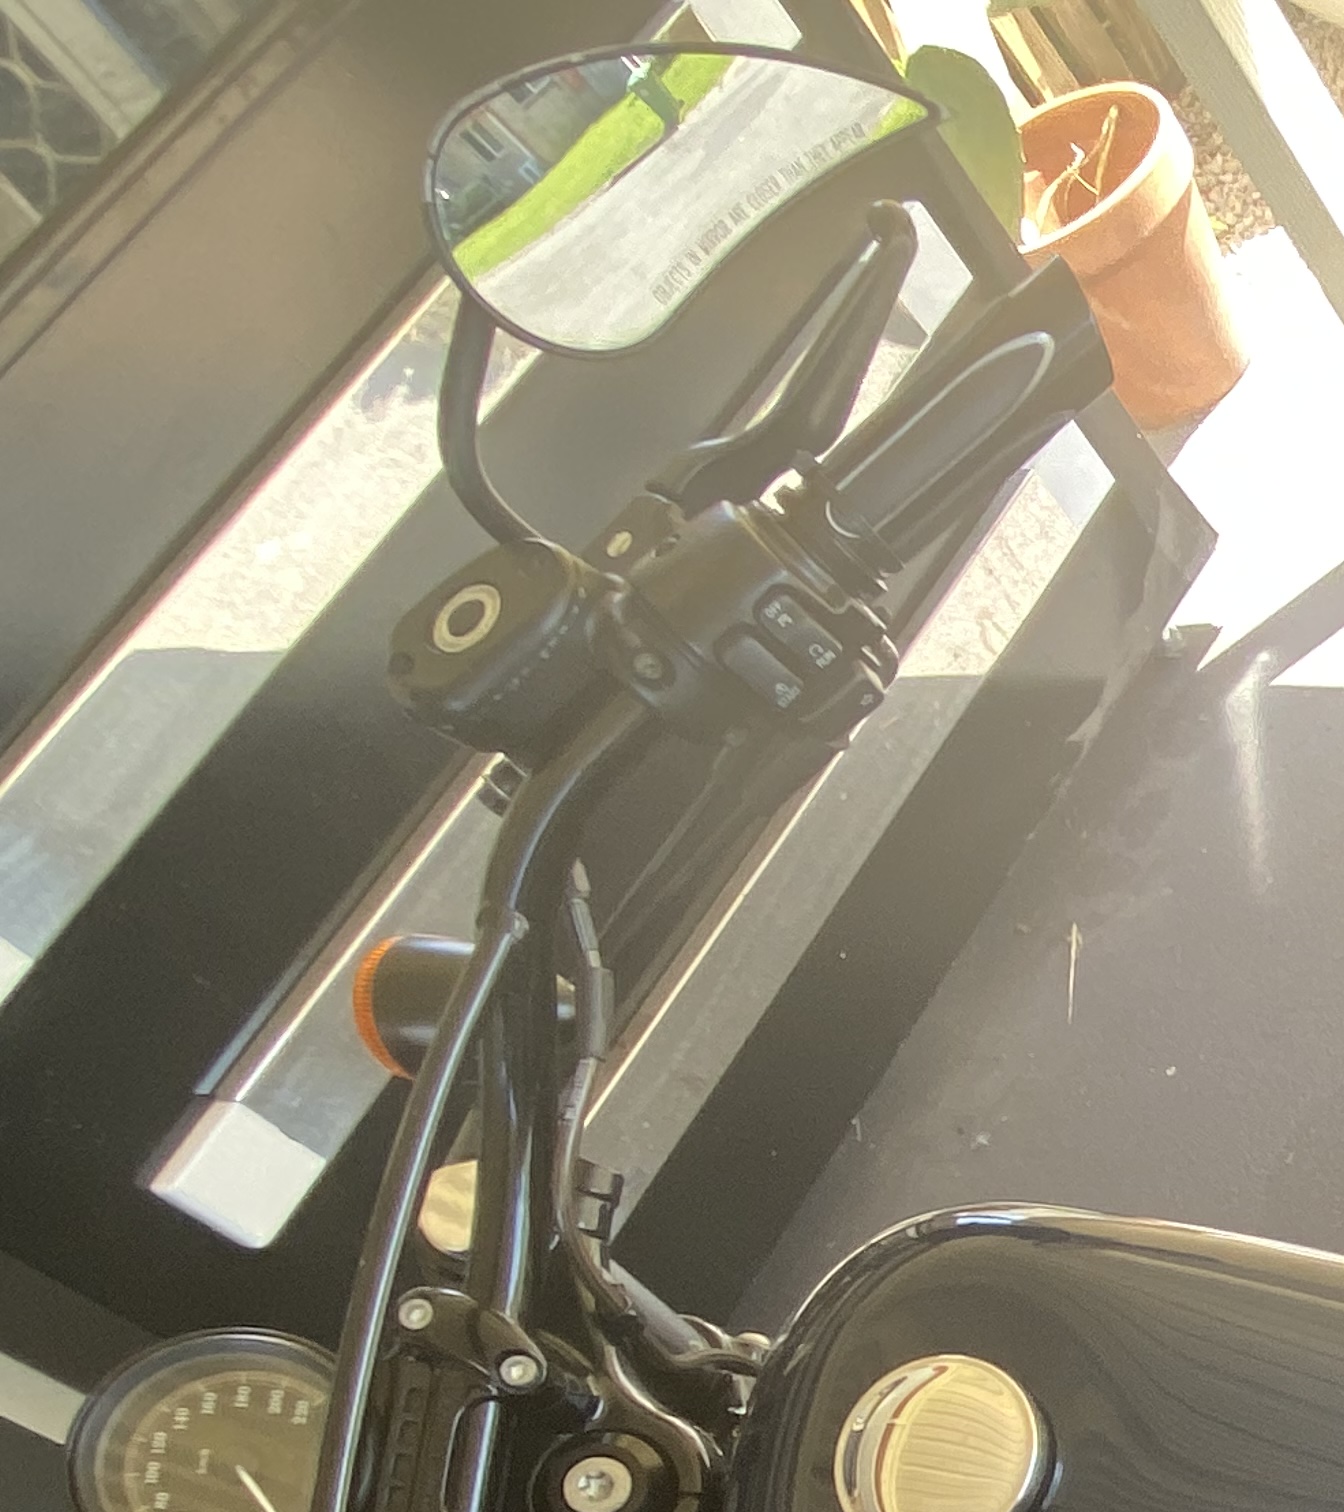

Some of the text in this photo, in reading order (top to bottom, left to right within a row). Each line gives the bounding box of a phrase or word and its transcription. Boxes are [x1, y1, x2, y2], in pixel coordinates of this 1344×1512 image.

[815, 649, 837, 669] RUN
[201, 1392, 217, 1415] 160
[267, 1389, 284, 1415] 200
[173, 1407, 190, 1430] 140
[150, 1431, 168, 1454] 120
[144, 1461, 161, 1484] 100
[154, 1492, 169, 1510] 80
